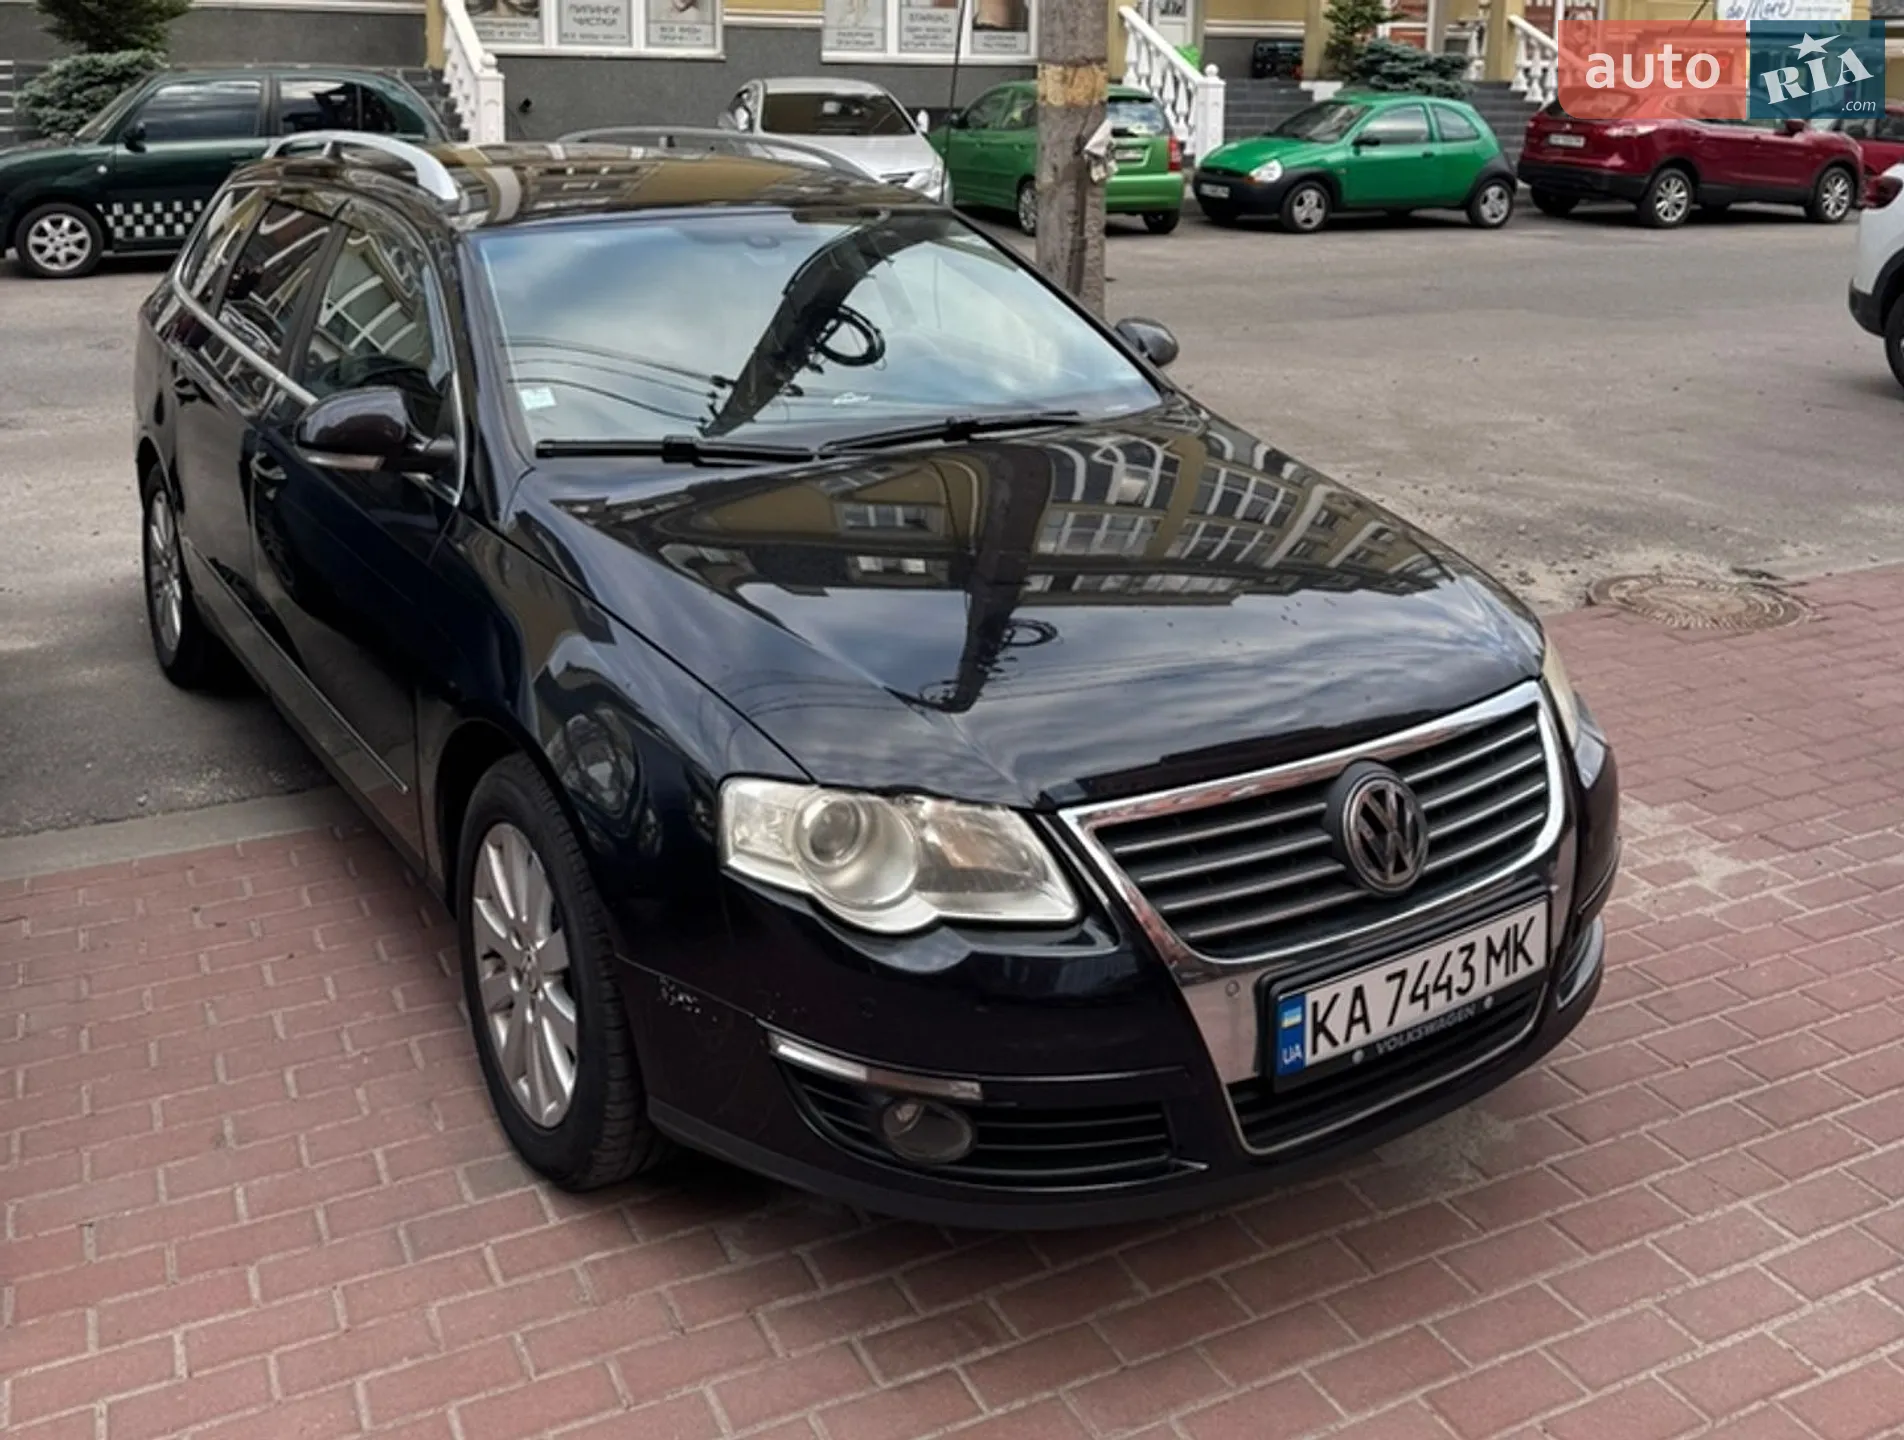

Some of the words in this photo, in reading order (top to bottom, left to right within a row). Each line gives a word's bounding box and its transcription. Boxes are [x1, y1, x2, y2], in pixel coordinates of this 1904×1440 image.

[572, 16, 618, 26] ЧИСТКИ
[1311, 984, 1371, 1056] KA
[1385, 942, 1477, 1027] 7443
[1486, 916, 1535, 987] MK
[1375, 1003, 1476, 1056] VOLKSWAGEN
[1282, 1044, 1303, 1065] UA
